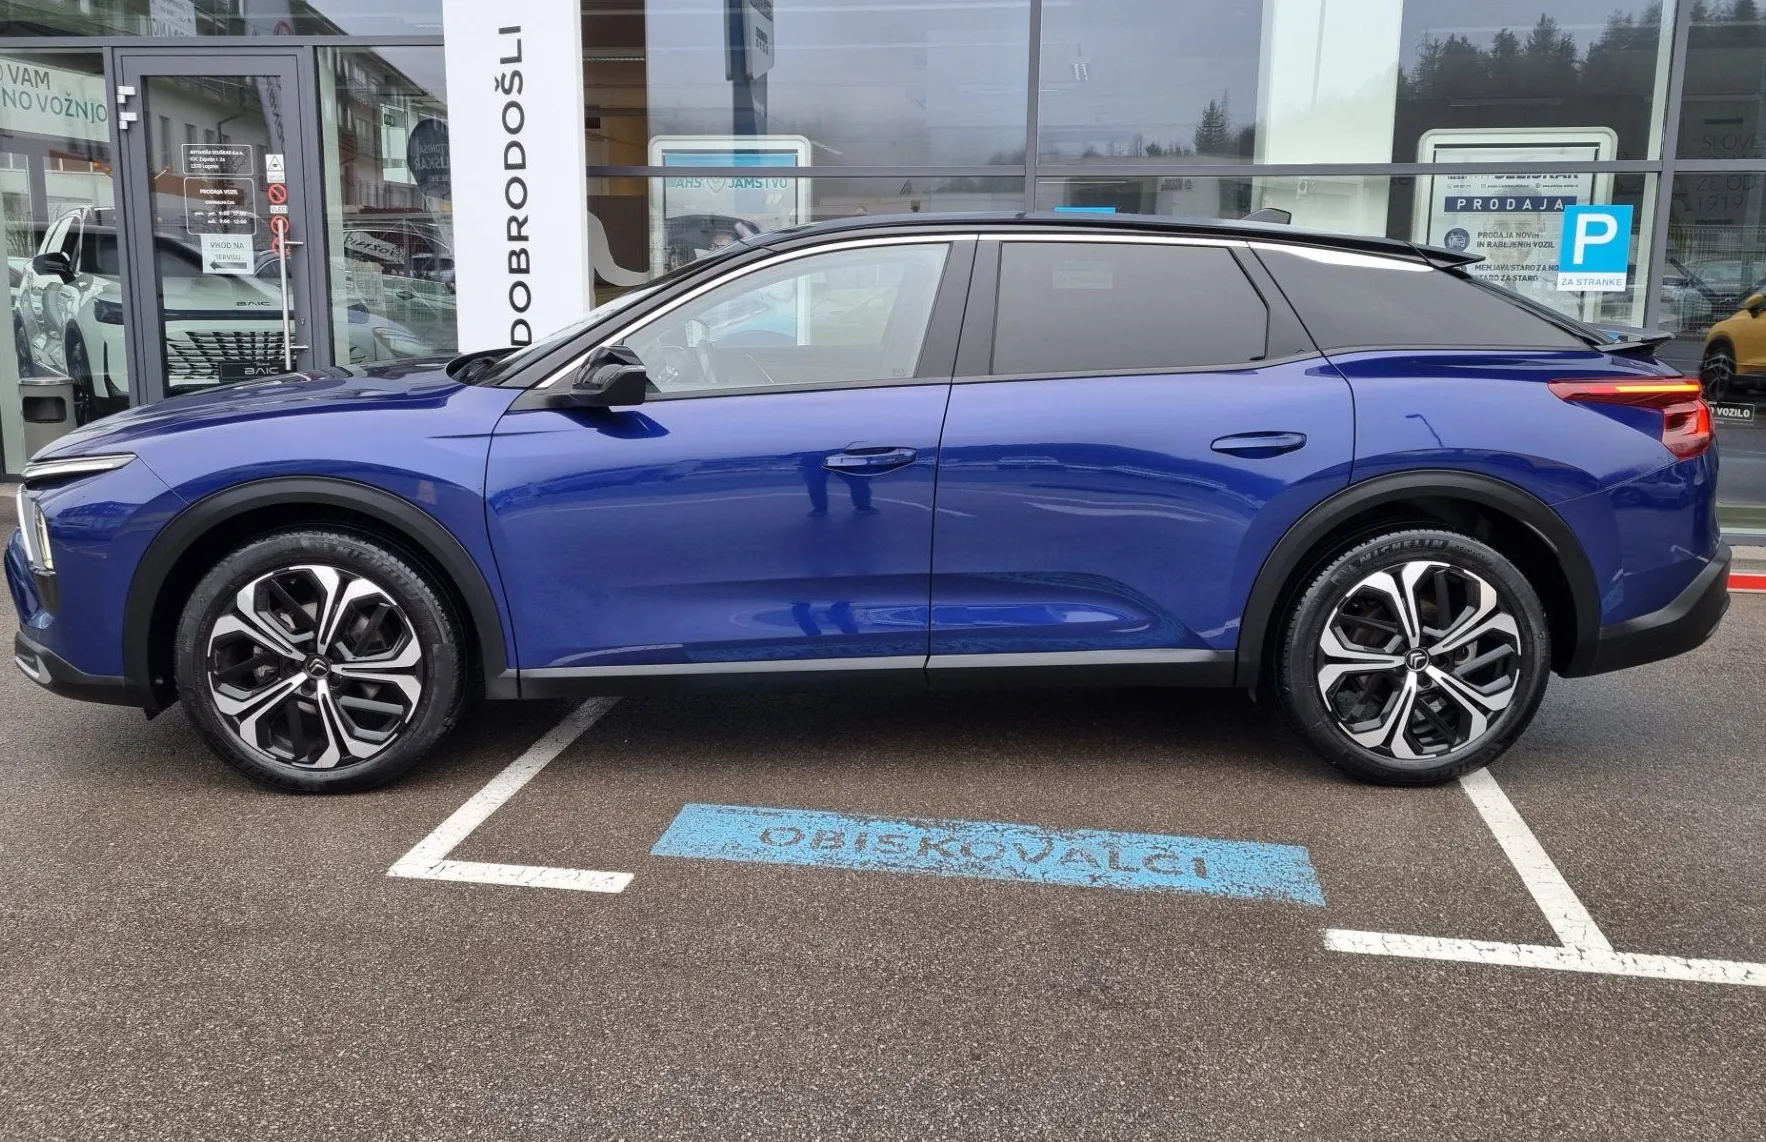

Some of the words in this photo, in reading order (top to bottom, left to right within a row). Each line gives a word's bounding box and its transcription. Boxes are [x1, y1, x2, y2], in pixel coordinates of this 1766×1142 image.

[7, 64, 50, 91] VAM
[36, 91, 108, 123] VOŽNJO
[494, 25, 532, 346] DOBRODOŠLI
[728, 177, 788, 189] JAMSTVO
[1456, 199, 1564, 210] PRODAJA
[1477, 231, 1514, 239] PRODAJA
[1572, 213, 1618, 265] P
[210, 241, 232, 249] VHOD
[1487, 241, 1532, 249] RABLJENIH
[1533, 241, 1555, 249] VOZIL
[1475, 264, 1510, 272] MENJAVA
[1511, 264, 1535, 272] STARO
[1536, 264, 1548, 272] ZA
[1561, 278, 1574, 287] ZA
[1575, 278, 1623, 288] STRANKE
[244, 366, 280, 376] BAIC
[1716, 406, 1751, 419] VOZILO
[1359, 539, 1450, 564] MICHELIN
[760, 823, 1208, 880] OBISKOVALCI
